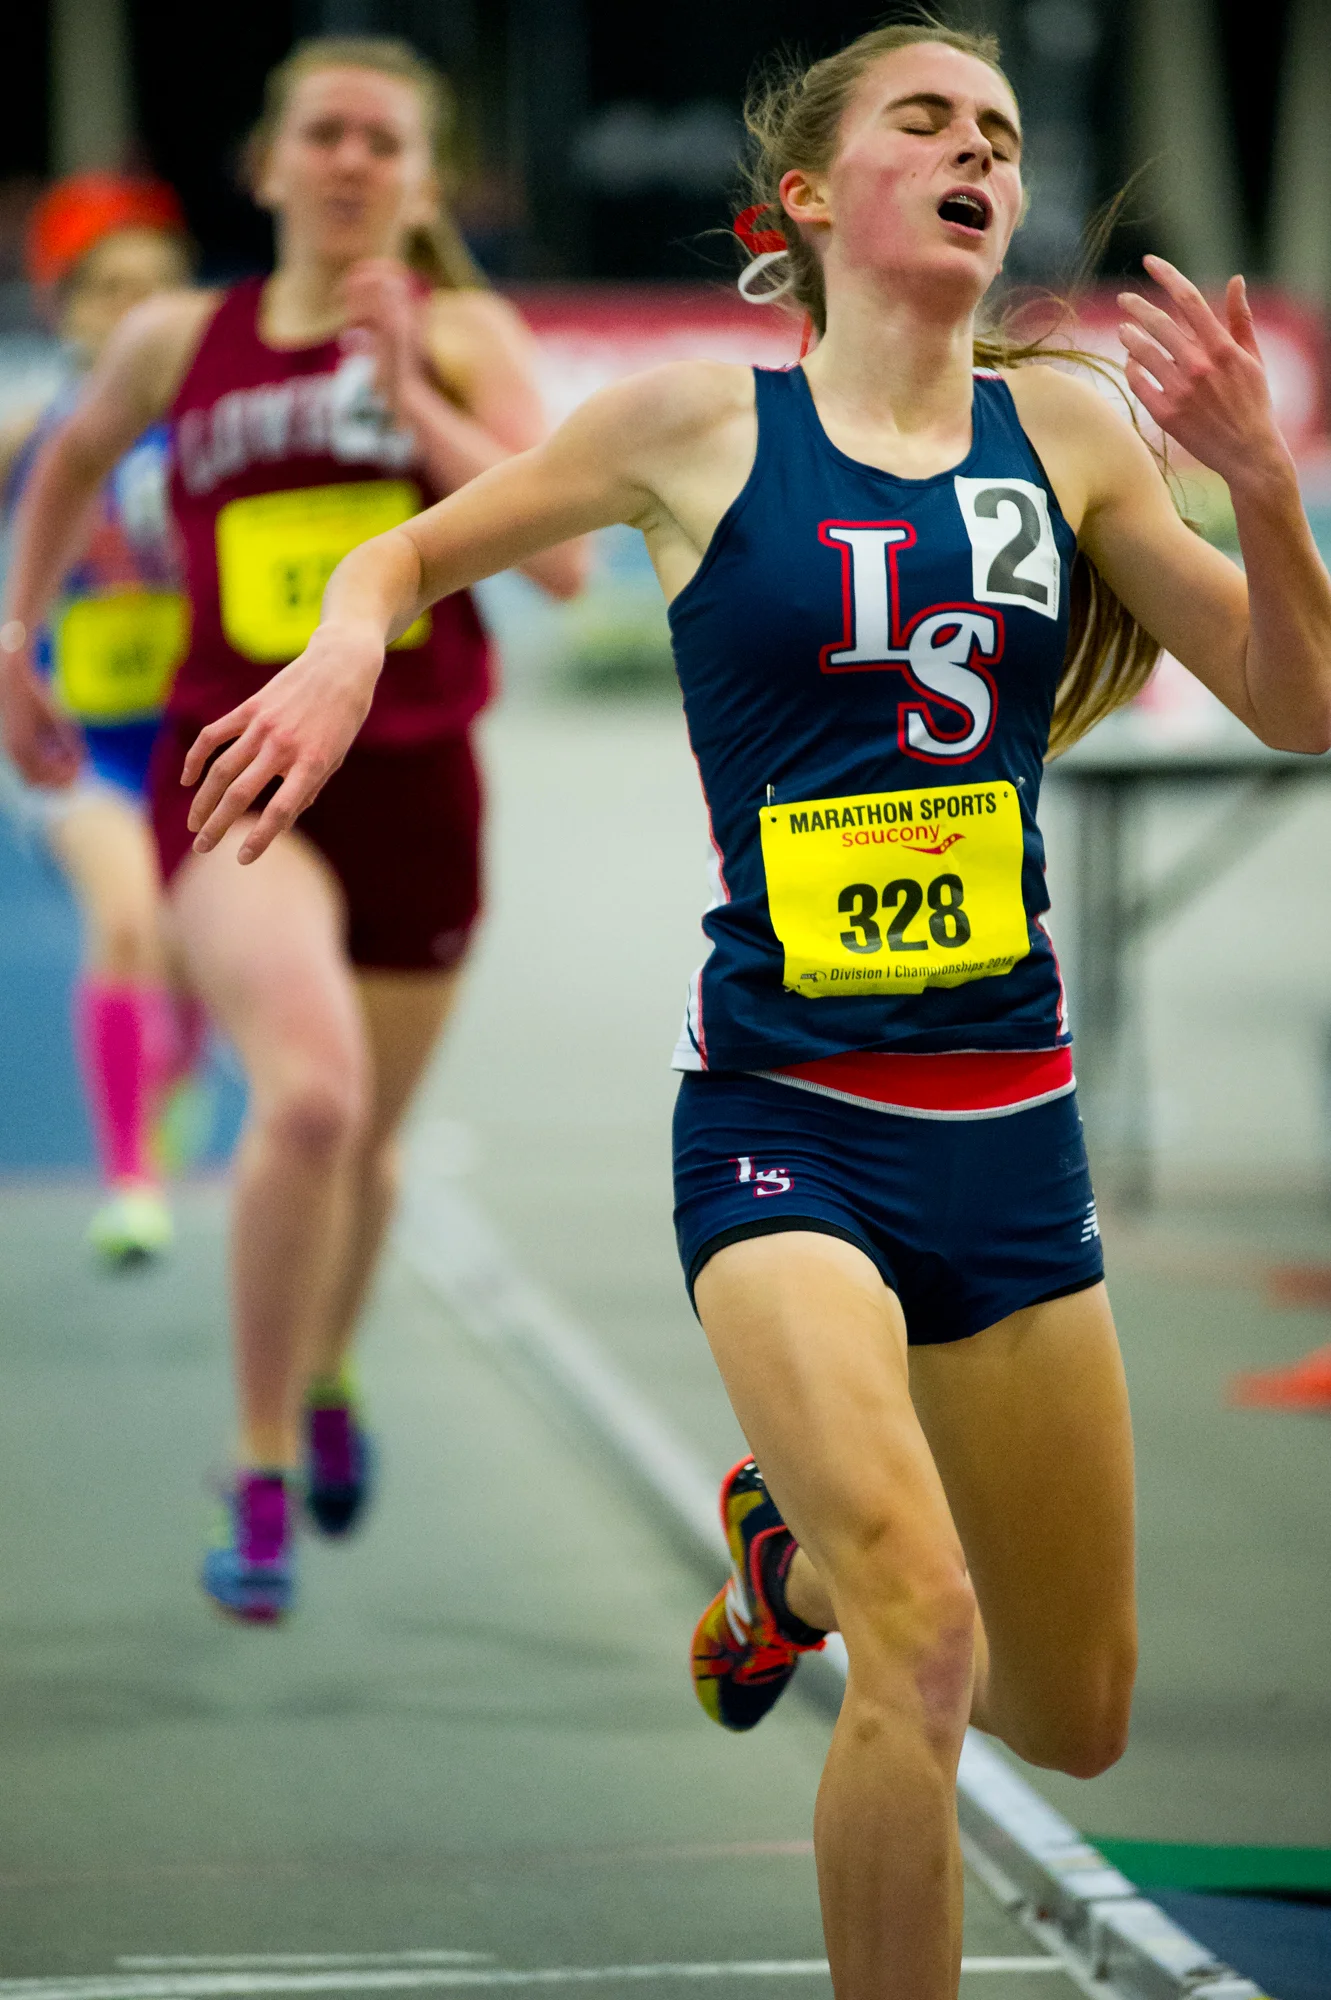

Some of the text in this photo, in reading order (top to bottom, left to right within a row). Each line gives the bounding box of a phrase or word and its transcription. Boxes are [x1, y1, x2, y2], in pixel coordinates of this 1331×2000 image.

[974, 487, 1048, 606] 2
[790, 792, 998, 834] MARATHON SPORTS
[842, 823, 942, 849] saucony
[837, 873, 971, 954] 328
[829, 967, 882, 981] Division
[894, 960, 985, 979] Championships
